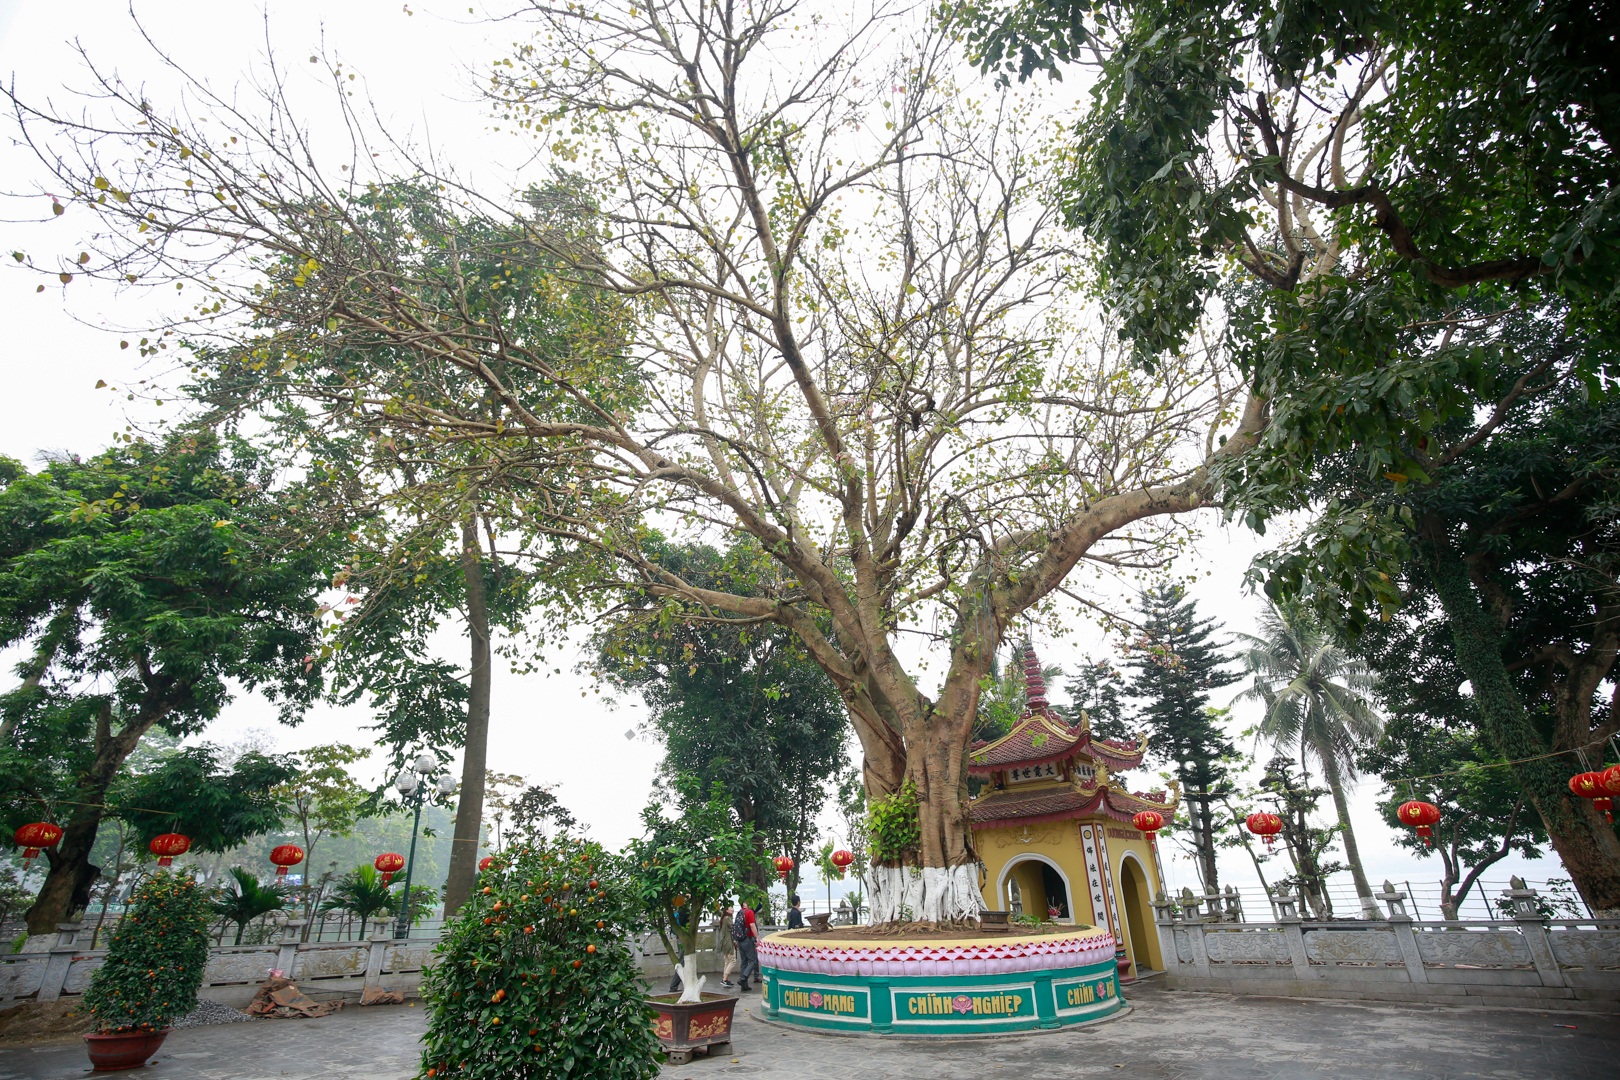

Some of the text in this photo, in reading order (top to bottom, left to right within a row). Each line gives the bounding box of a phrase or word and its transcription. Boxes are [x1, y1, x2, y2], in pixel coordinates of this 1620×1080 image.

[784, 987, 810, 1008] CHÍNH
[823, 994, 855, 1015] MẠNG
[908, 993, 953, 1015] CHÍNH
[1067, 982, 1095, 1006] CHÍNH
